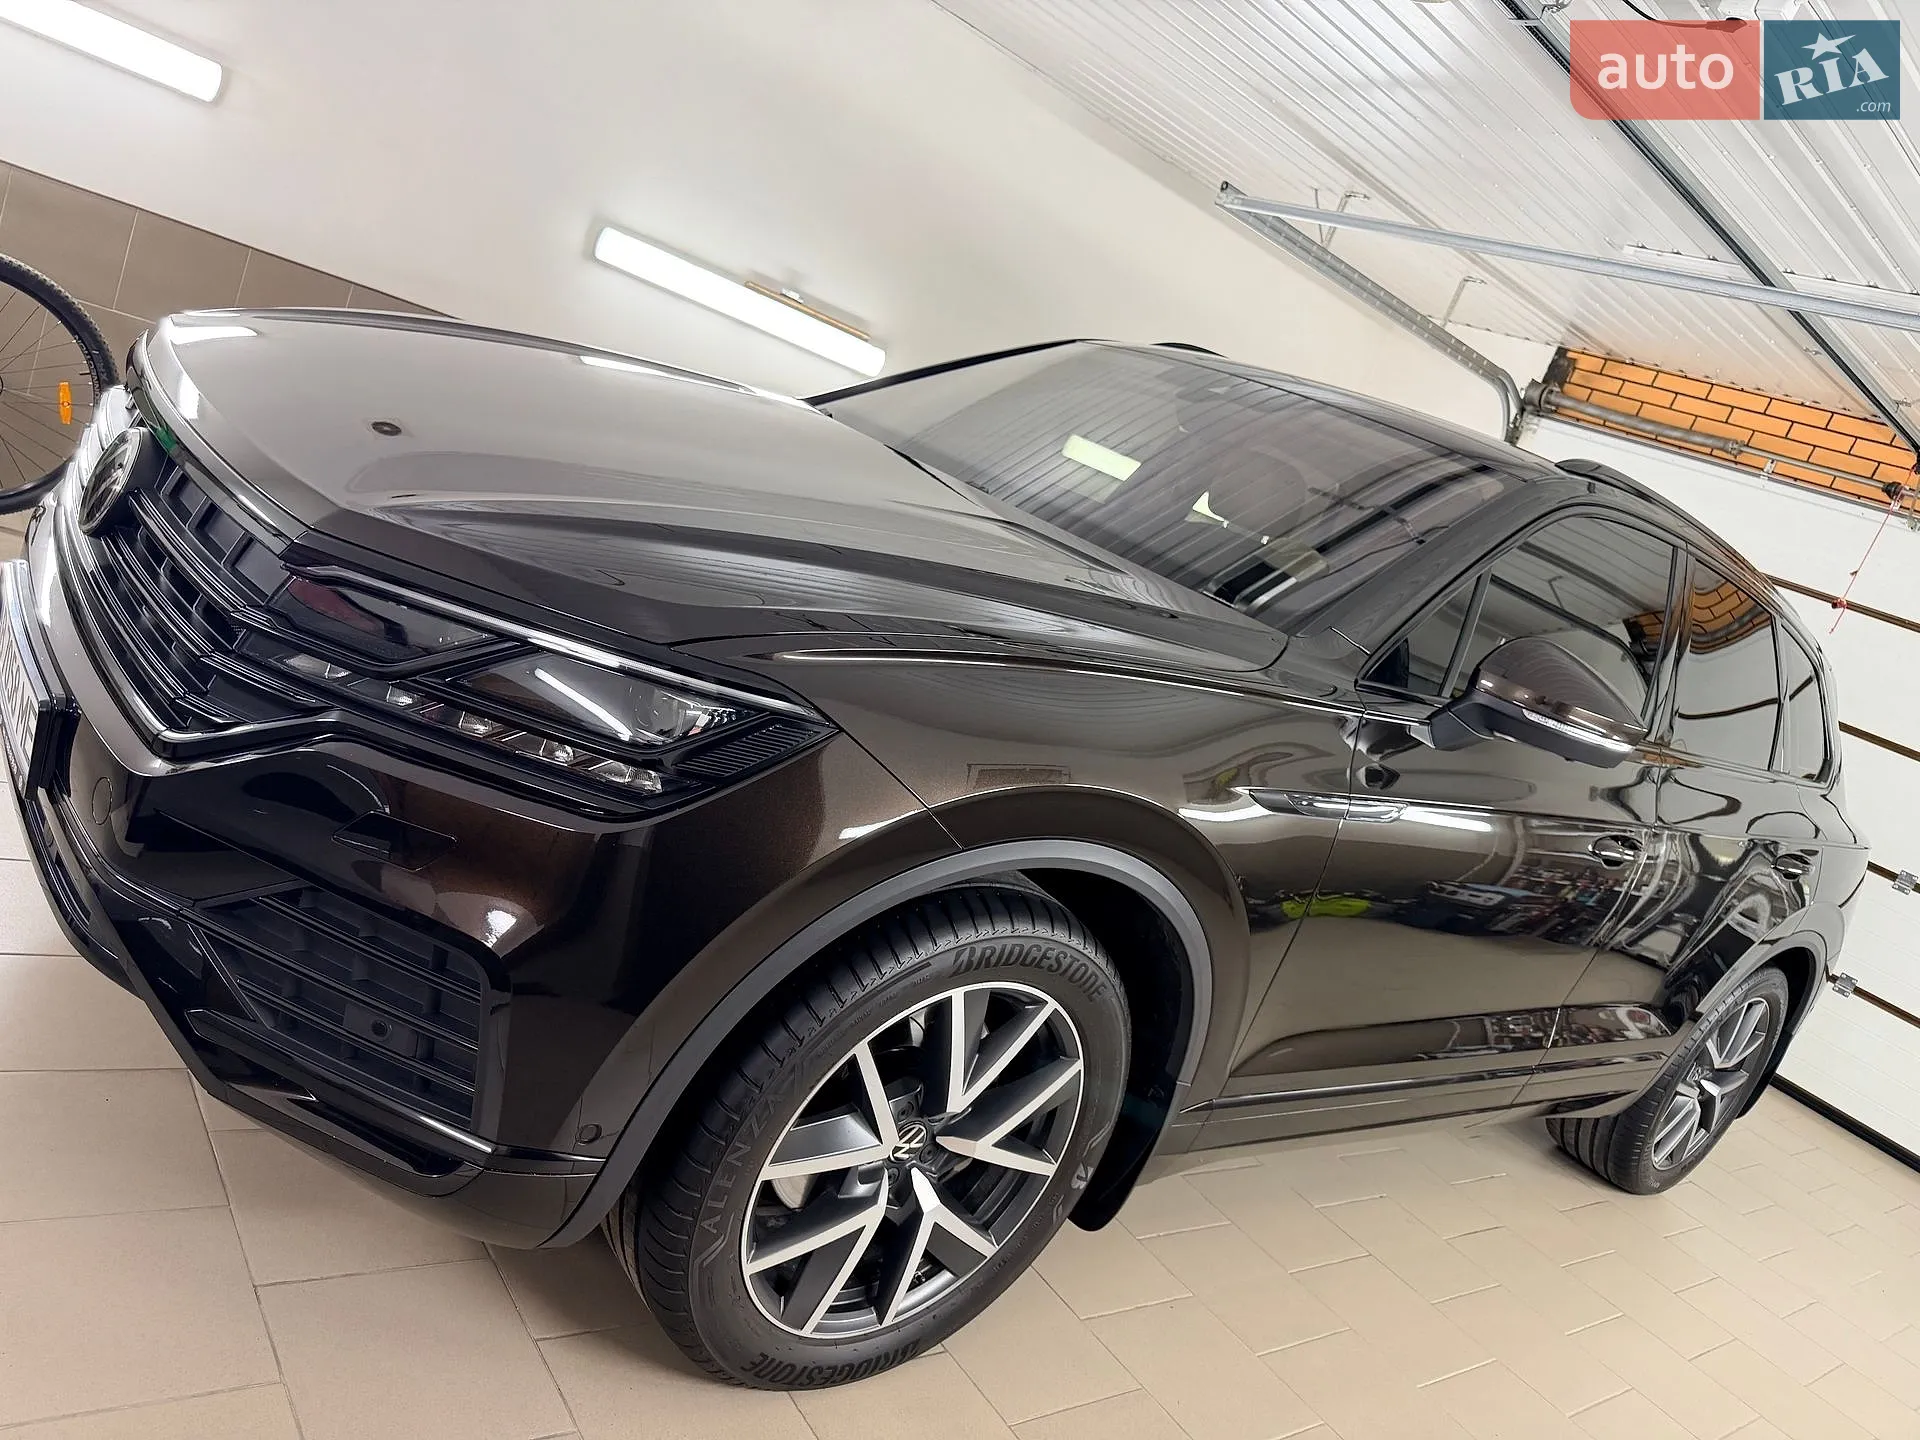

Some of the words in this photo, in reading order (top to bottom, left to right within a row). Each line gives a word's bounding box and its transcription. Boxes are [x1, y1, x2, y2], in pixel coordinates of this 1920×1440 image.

[950, 943, 1108, 1003] BRIDGESTONE
[700, 1093, 786, 1234] ALENZA
[741, 1338, 920, 1386] BRIDGESTONE
